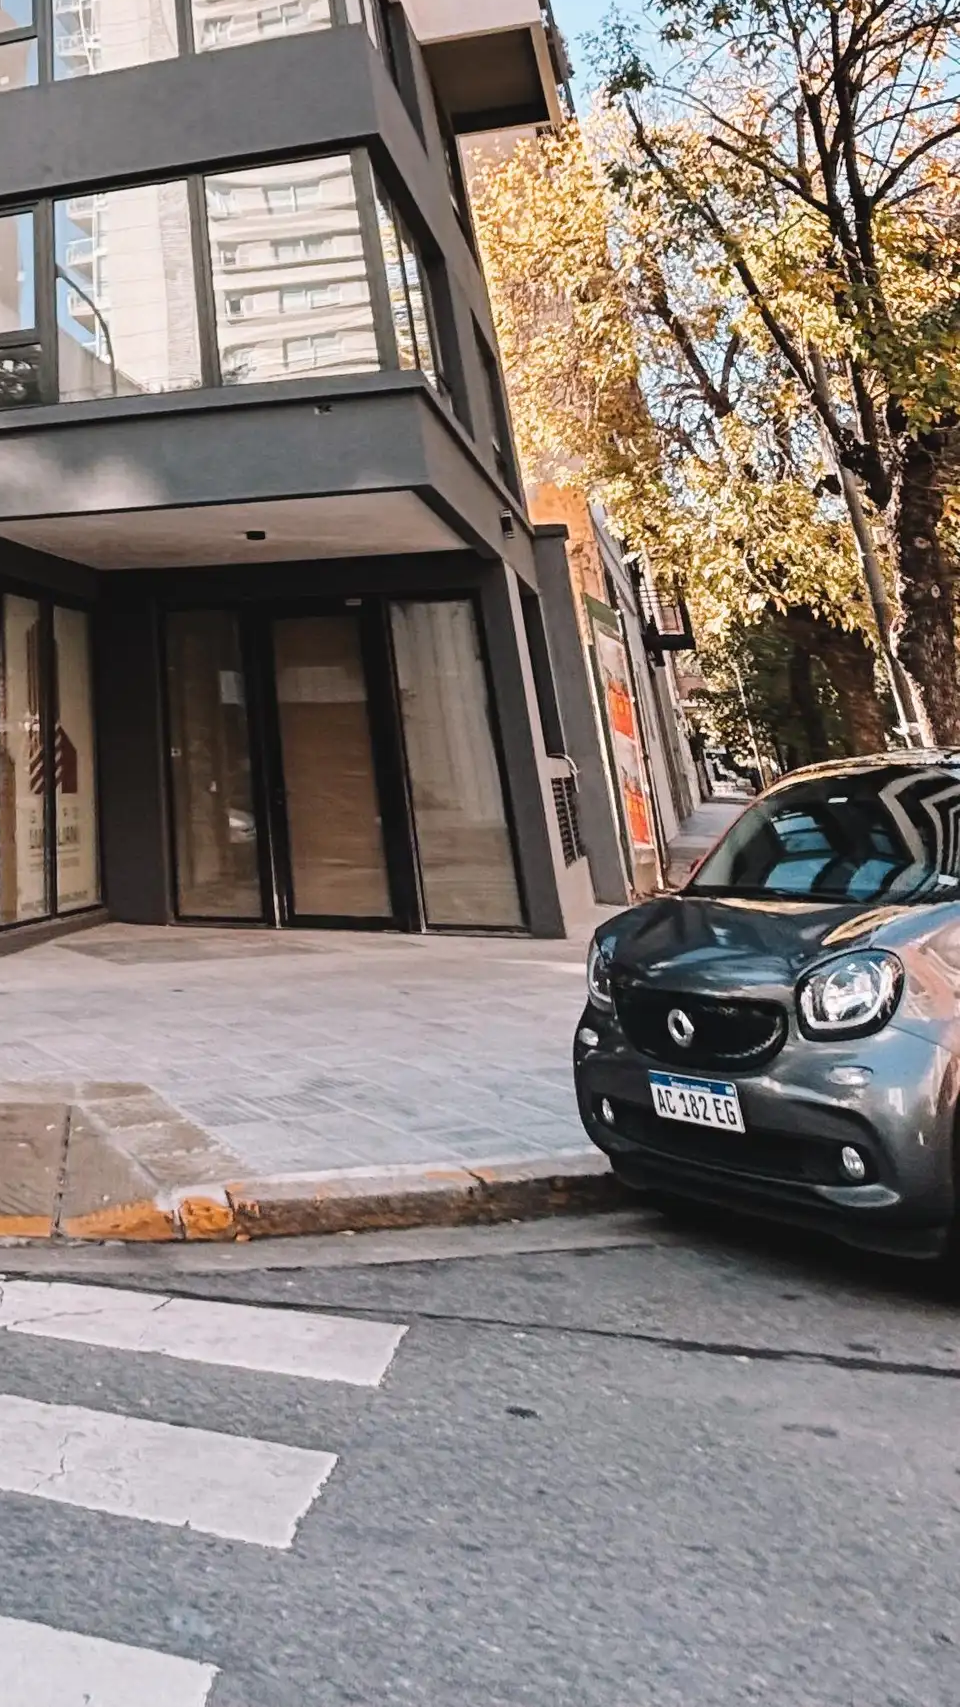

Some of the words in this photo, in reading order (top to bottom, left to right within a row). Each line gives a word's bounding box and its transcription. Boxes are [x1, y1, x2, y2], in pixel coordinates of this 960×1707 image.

[657, 1088, 676, 1114] AC
[679, 1092, 711, 1121] 182
[713, 1098, 737, 1125] EG
